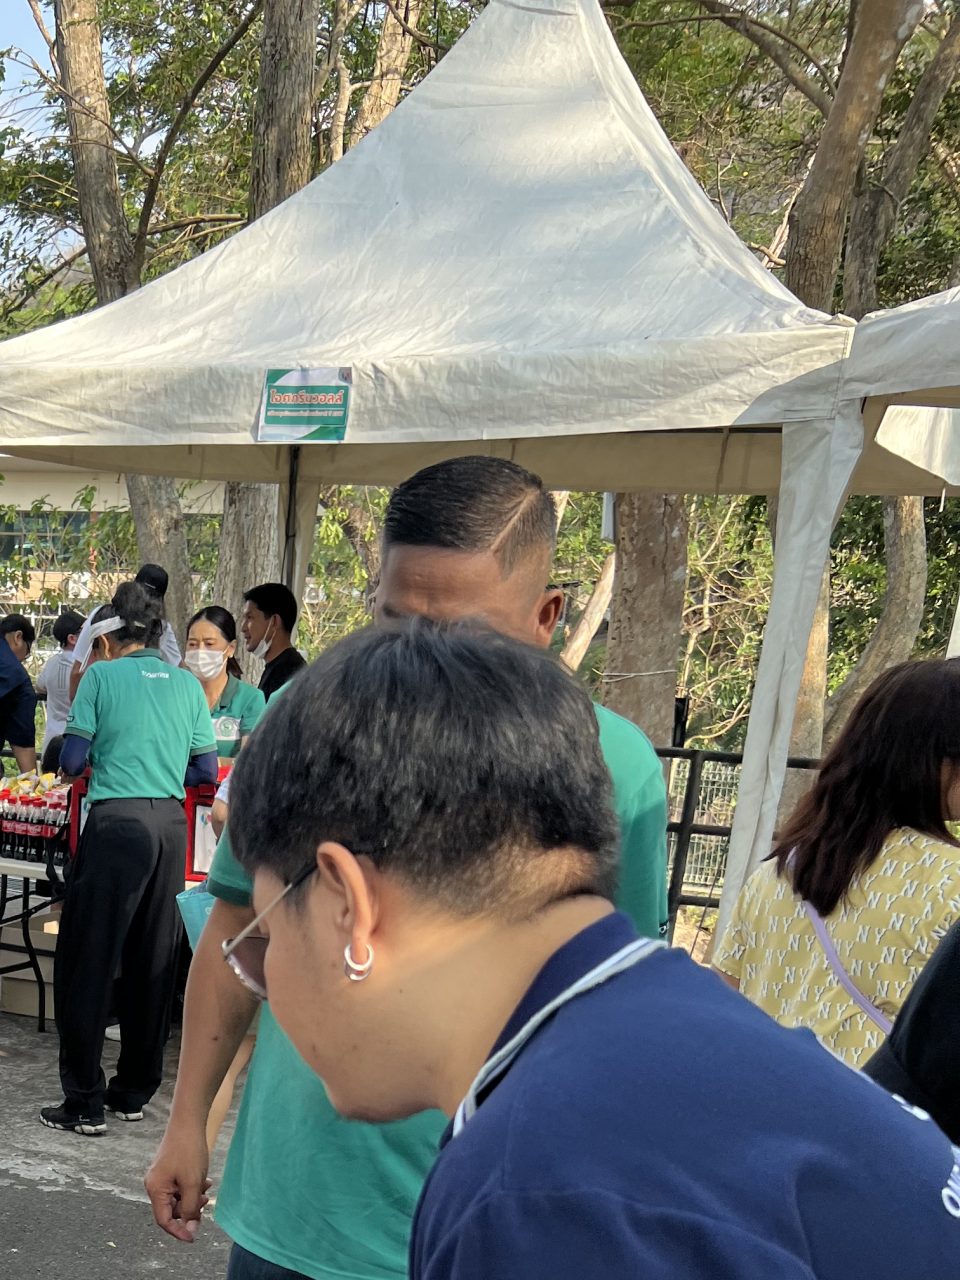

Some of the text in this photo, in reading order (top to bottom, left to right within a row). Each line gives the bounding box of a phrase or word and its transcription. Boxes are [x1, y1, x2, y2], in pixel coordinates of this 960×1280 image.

[880, 859, 916, 879] NY
[917, 851, 954, 872] NY
[900, 880, 934, 900] NY
[866, 891, 899, 911] NY
[768, 916, 793, 934] NY
[889, 912, 920, 933] NY
[788, 934, 817, 951] NY
[856, 925, 887, 944] NY
[765, 949, 787, 966] NY
[880, 946, 914, 965] NY
[784, 967, 808, 984] NY
[851, 960, 879, 979] NY
[761, 981, 783, 998] NY
[800, 983, 825, 1002] NY
[877, 980, 907, 998] NY
[817, 1002, 848, 1020] NY
